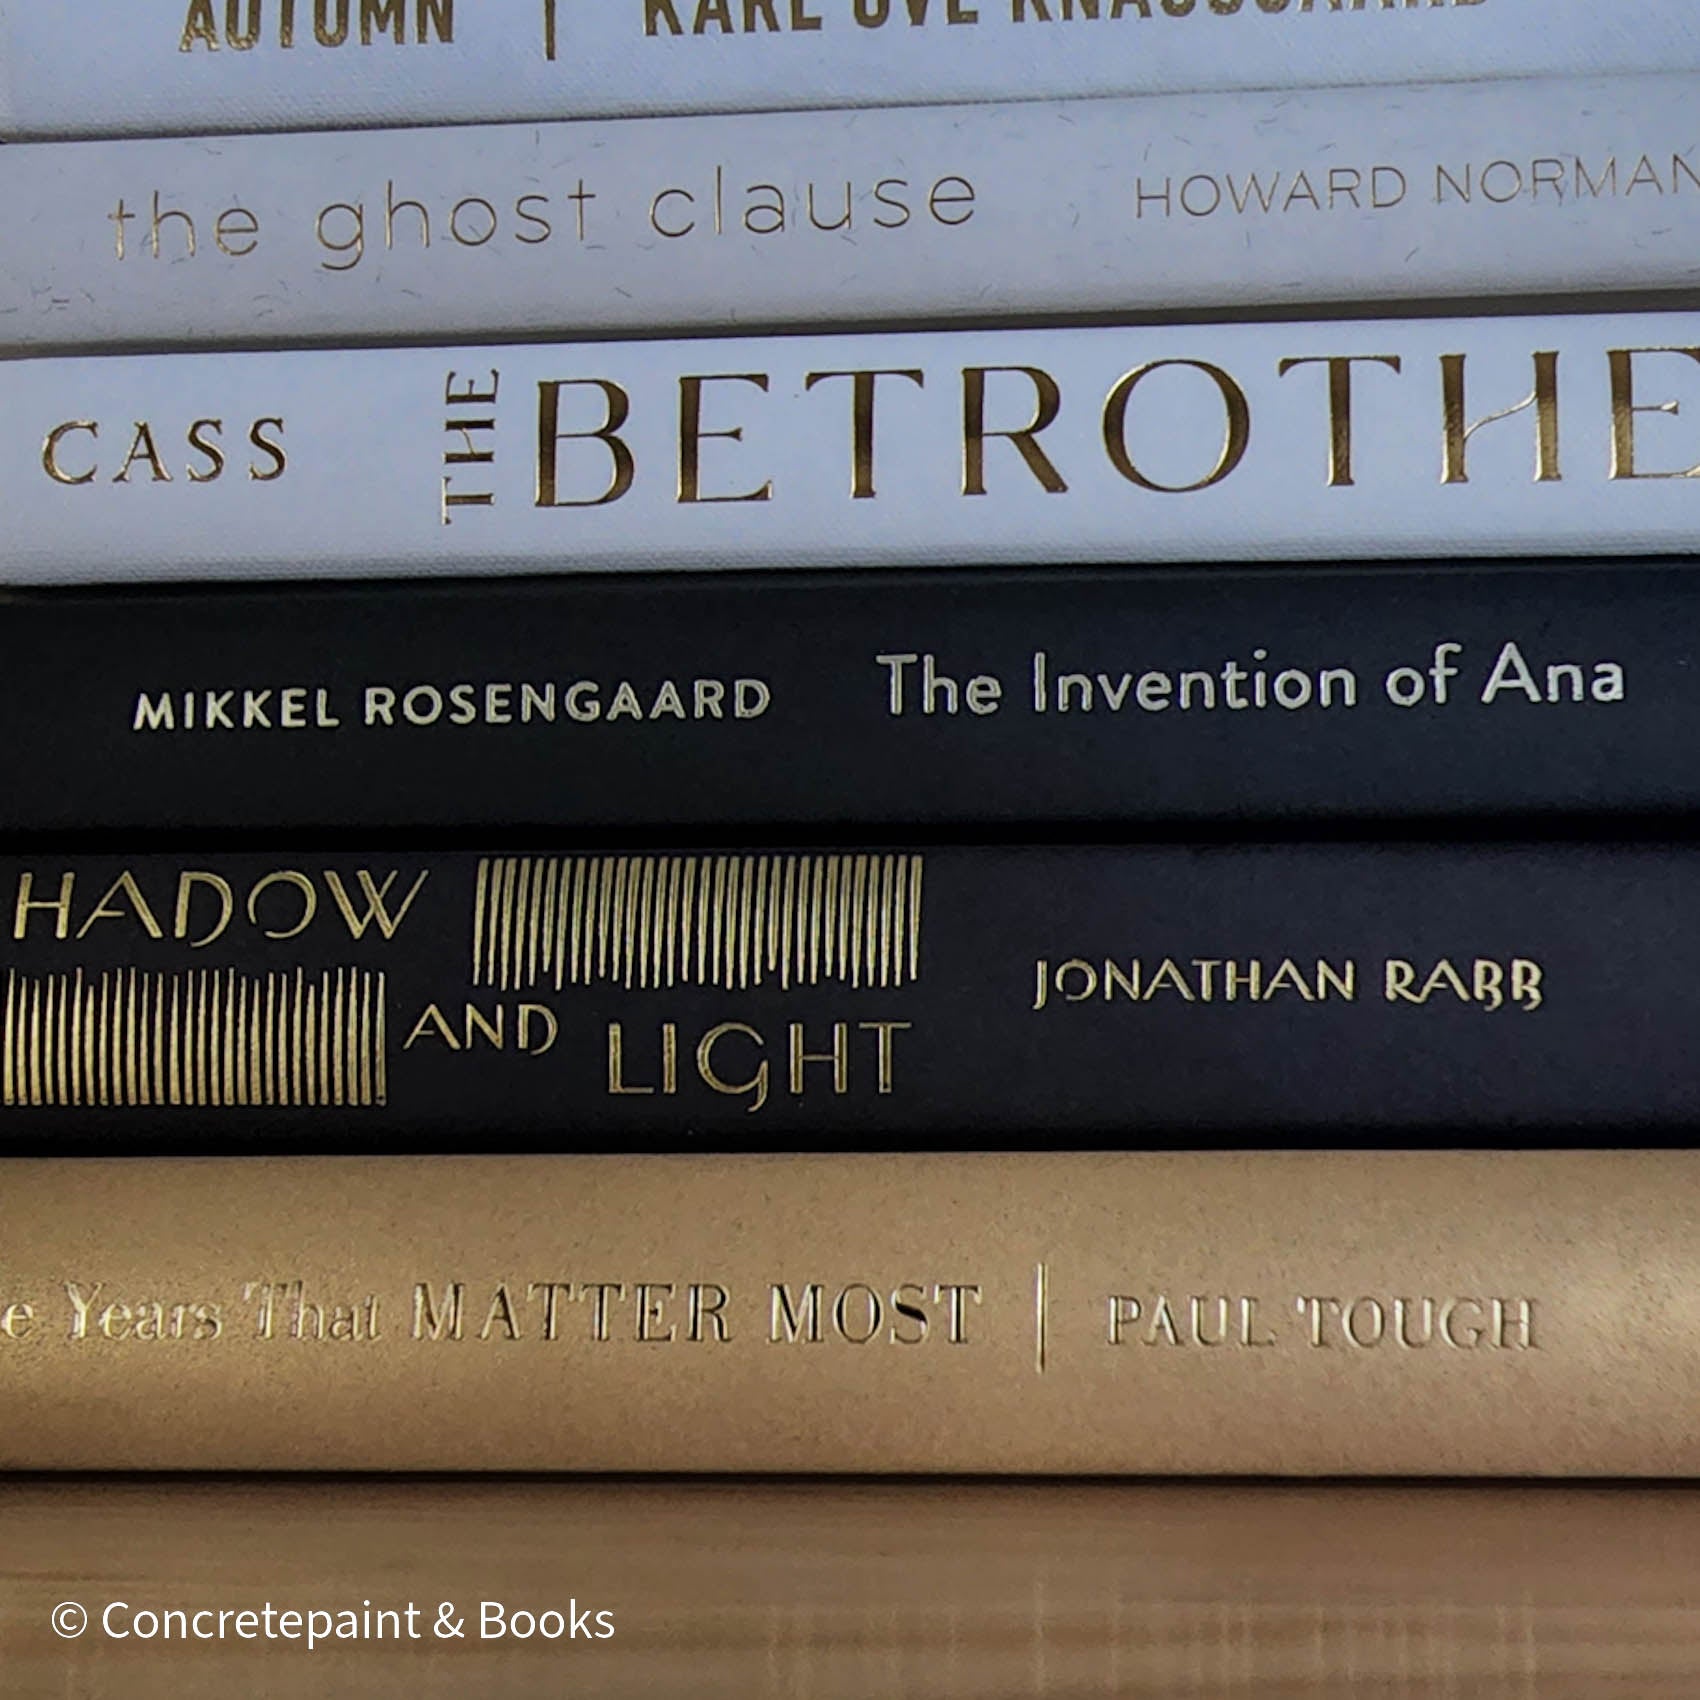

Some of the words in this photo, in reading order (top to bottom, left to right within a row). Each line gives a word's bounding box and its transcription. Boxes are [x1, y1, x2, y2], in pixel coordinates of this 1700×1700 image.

[179, 0, 453, 52] AUTUMN
[107, 189, 260, 261] the
[315, 179, 597, 270] ghost
[648, 165, 976, 238] clause
[1135, 165, 1407, 220] HOWARD
[41, 416, 289, 486] CASS
[440, 366, 500, 525] THE
[534, 348, 1700, 508] BETROTHE
[132, 687, 340, 731] MIKKEL
[364, 678, 771, 726] ROSENGAARD
[875, 653, 1003, 715] The
[1033, 648, 1357, 713] Invention
[1384, 641, 1463, 707] of
[1480, 641, 1625, 704] Ana
[13, 869, 429, 947] HADOW
[1032, 957, 1356, 1011] JONATHAN
[1384, 958, 1544, 1012] RABB
[403, 1002, 559, 1054] AND
[607, 1021, 912, 1113] LIGHT
[64, 1280, 223, 1340] Years
[243, 1279, 382, 1341] That
[411, 1282, 733, 1343] MATTER
[767, 1283, 983, 1345] MOST
[1106, 1295, 1275, 1347] PAUL
[1296, 1296, 1540, 1350] TOUGH
